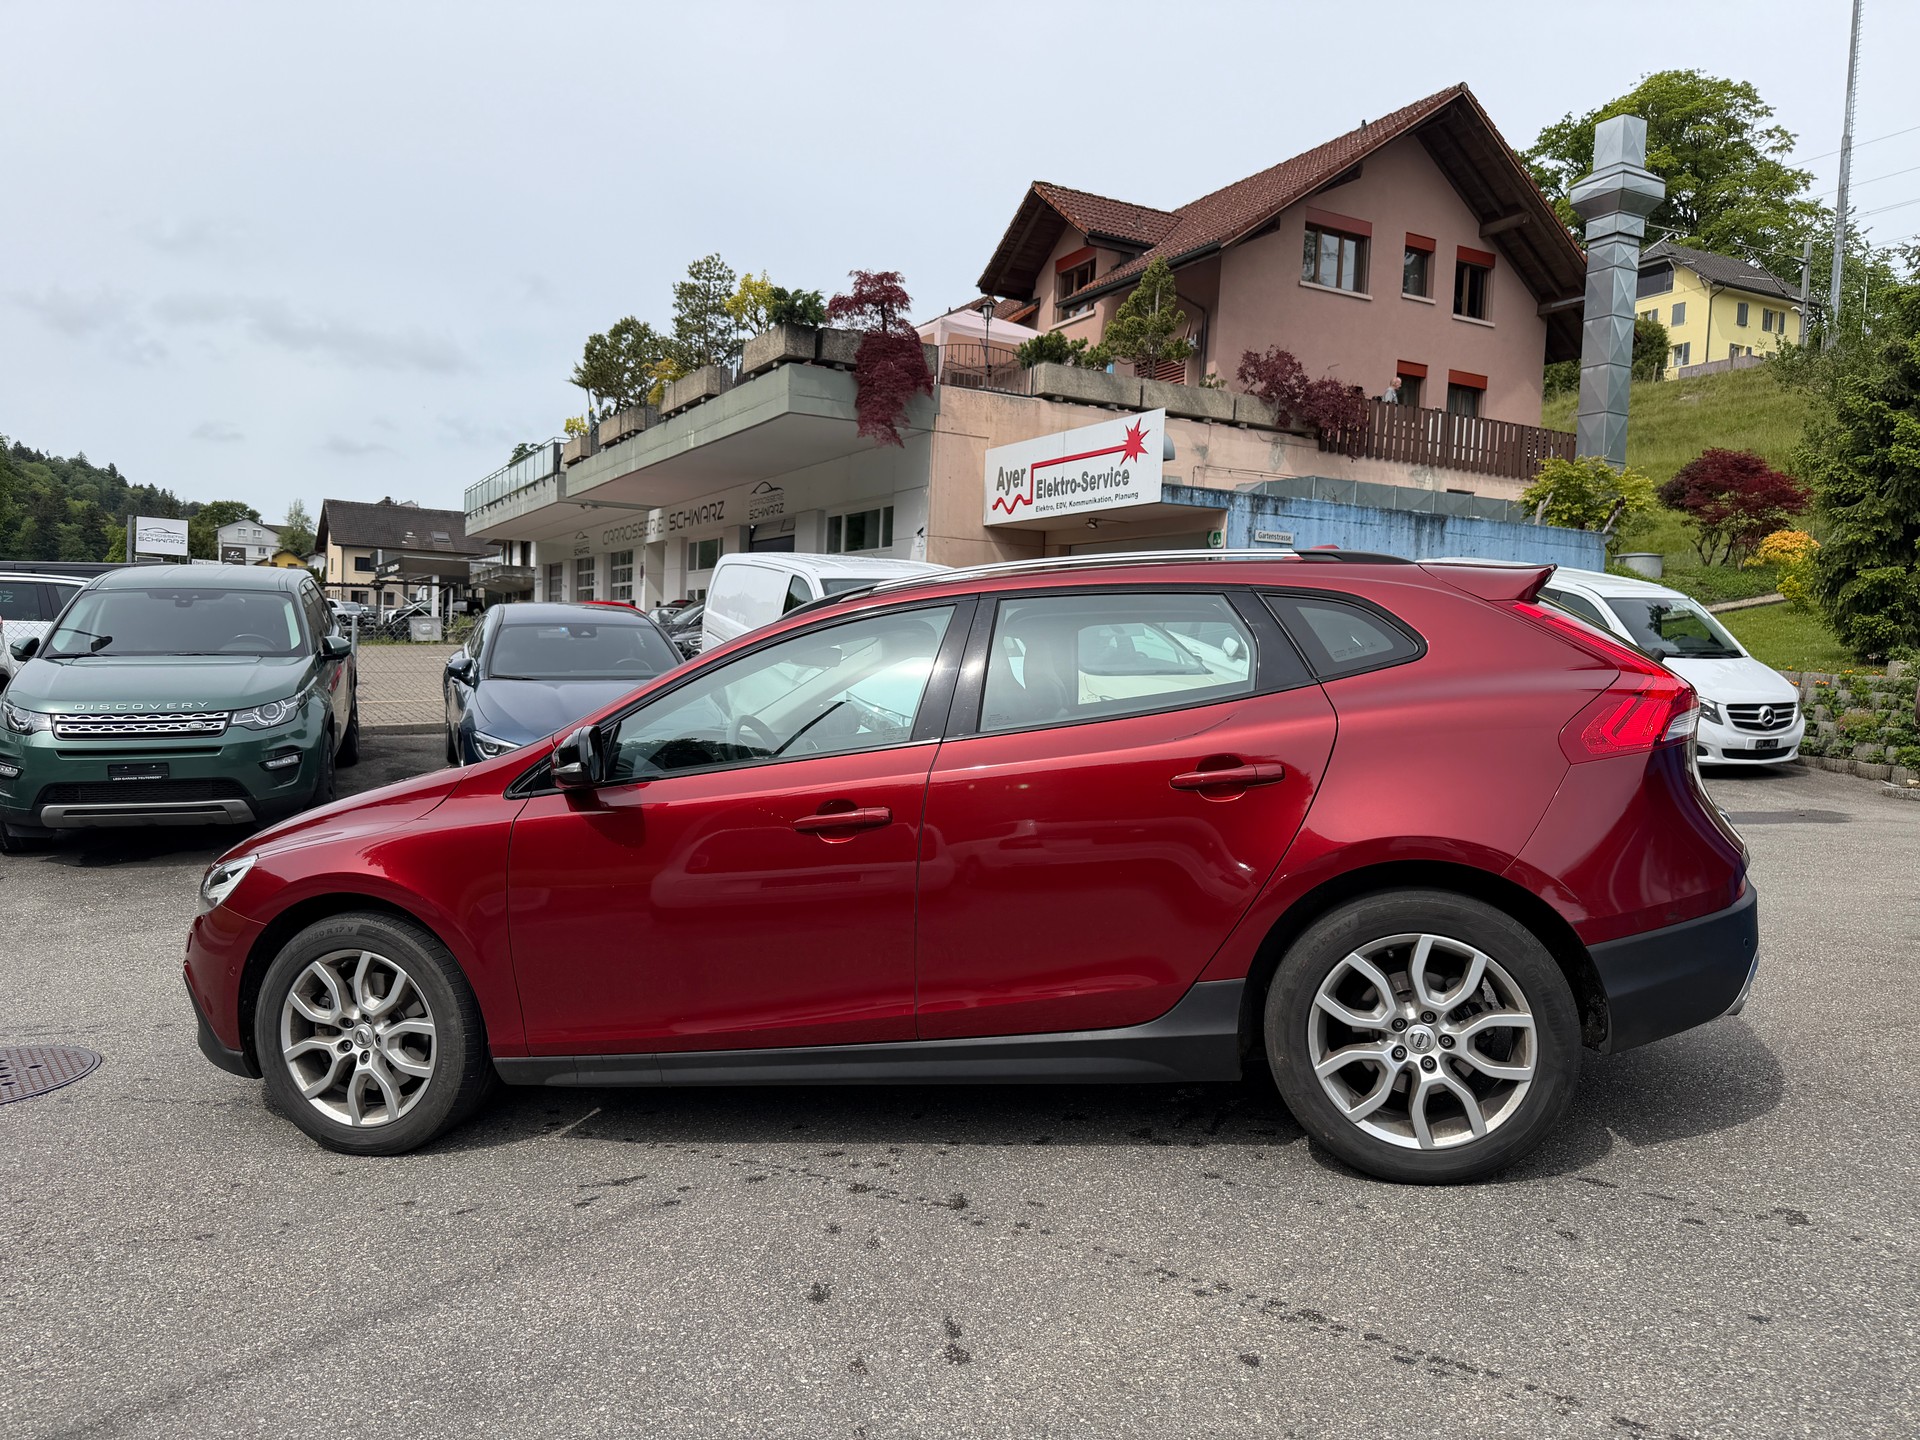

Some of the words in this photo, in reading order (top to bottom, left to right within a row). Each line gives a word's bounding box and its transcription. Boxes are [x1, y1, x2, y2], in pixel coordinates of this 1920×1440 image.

[996, 466, 1026, 496] Ayer
[1036, 466, 1130, 499] Elektro-Service
[1035, 505, 1055, 513] Elektro,
[1055, 502, 1068, 510] EDV,
[1068, 496, 1114, 508] Kommunikation,
[1114, 491, 1139, 501] Planung
[602, 516, 665, 546] CARROSSERIE
[668, 500, 725, 532] SCHWARZ
[138, 537, 186, 545] SCHWARZ
[1258, 531, 1291, 541] Gartenstrasse
[74, 701, 209, 711] DISCOVERY
